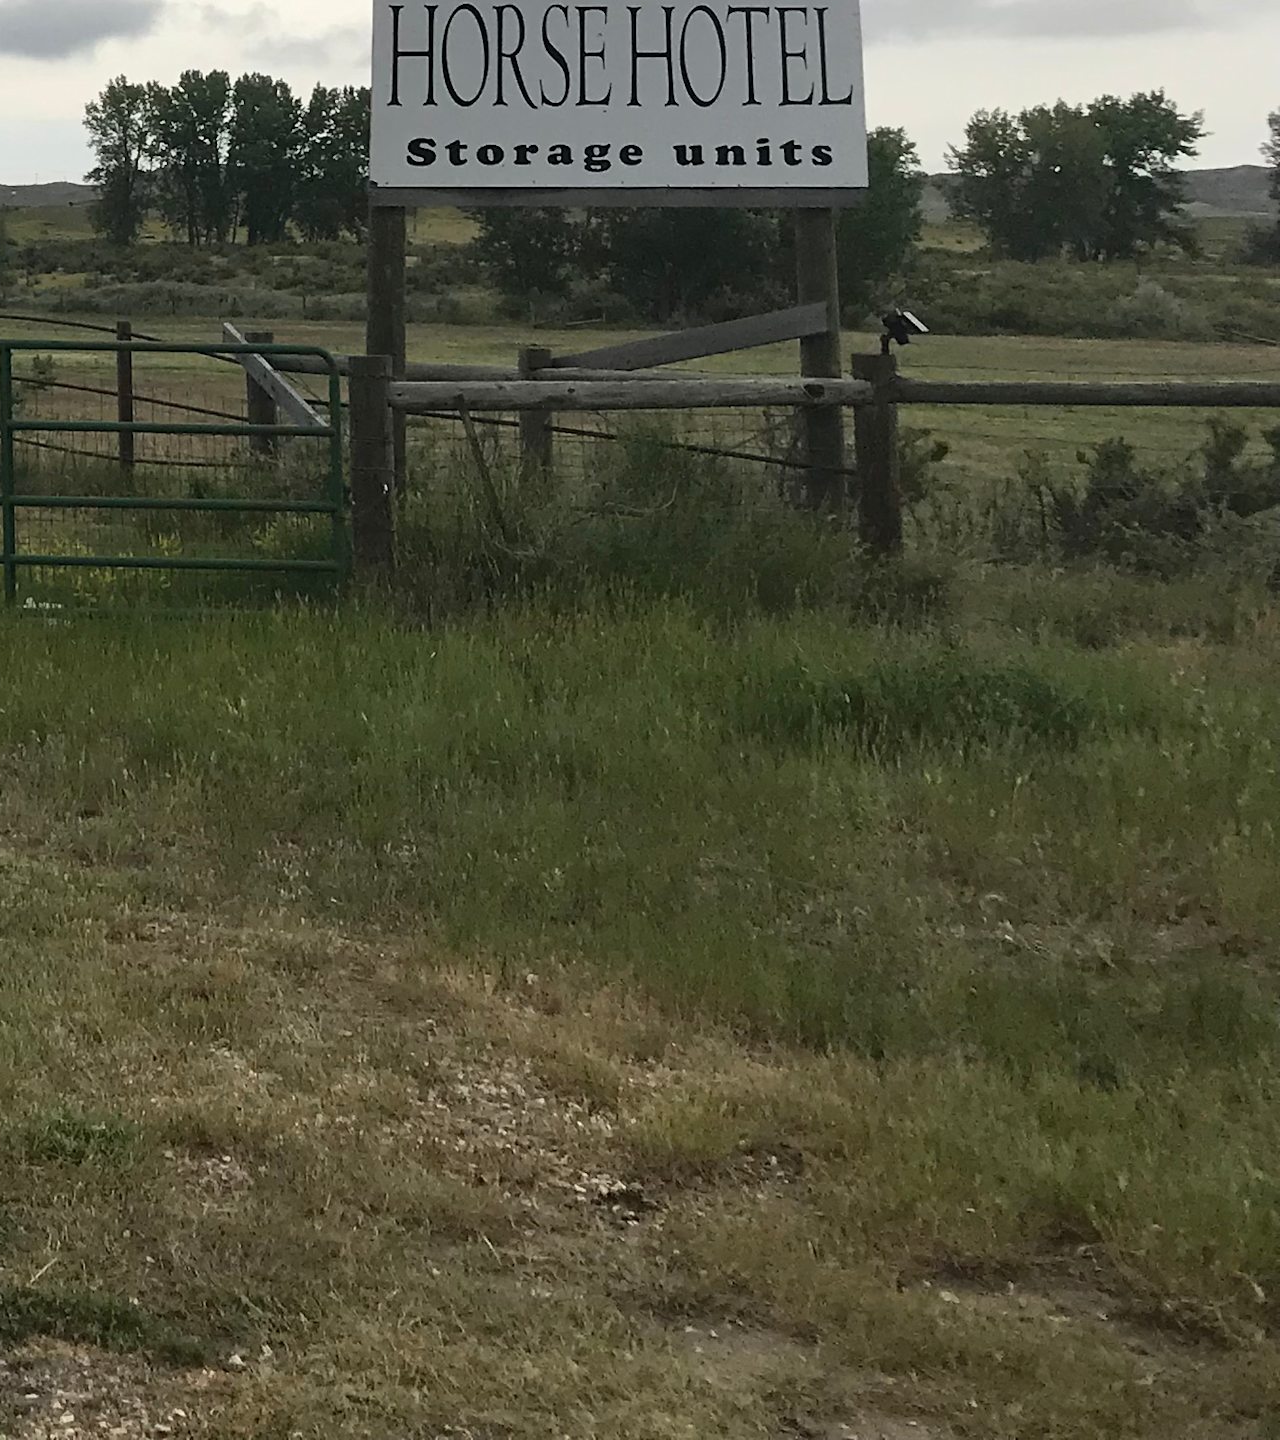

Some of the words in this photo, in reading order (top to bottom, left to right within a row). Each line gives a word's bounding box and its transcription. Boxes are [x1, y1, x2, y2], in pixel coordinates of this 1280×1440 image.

[386, 3, 612, 109] HORSE
[626, 5, 854, 108] HOTEL
[406, 137, 644, 172] Storage
[673, 137, 833, 167] units
